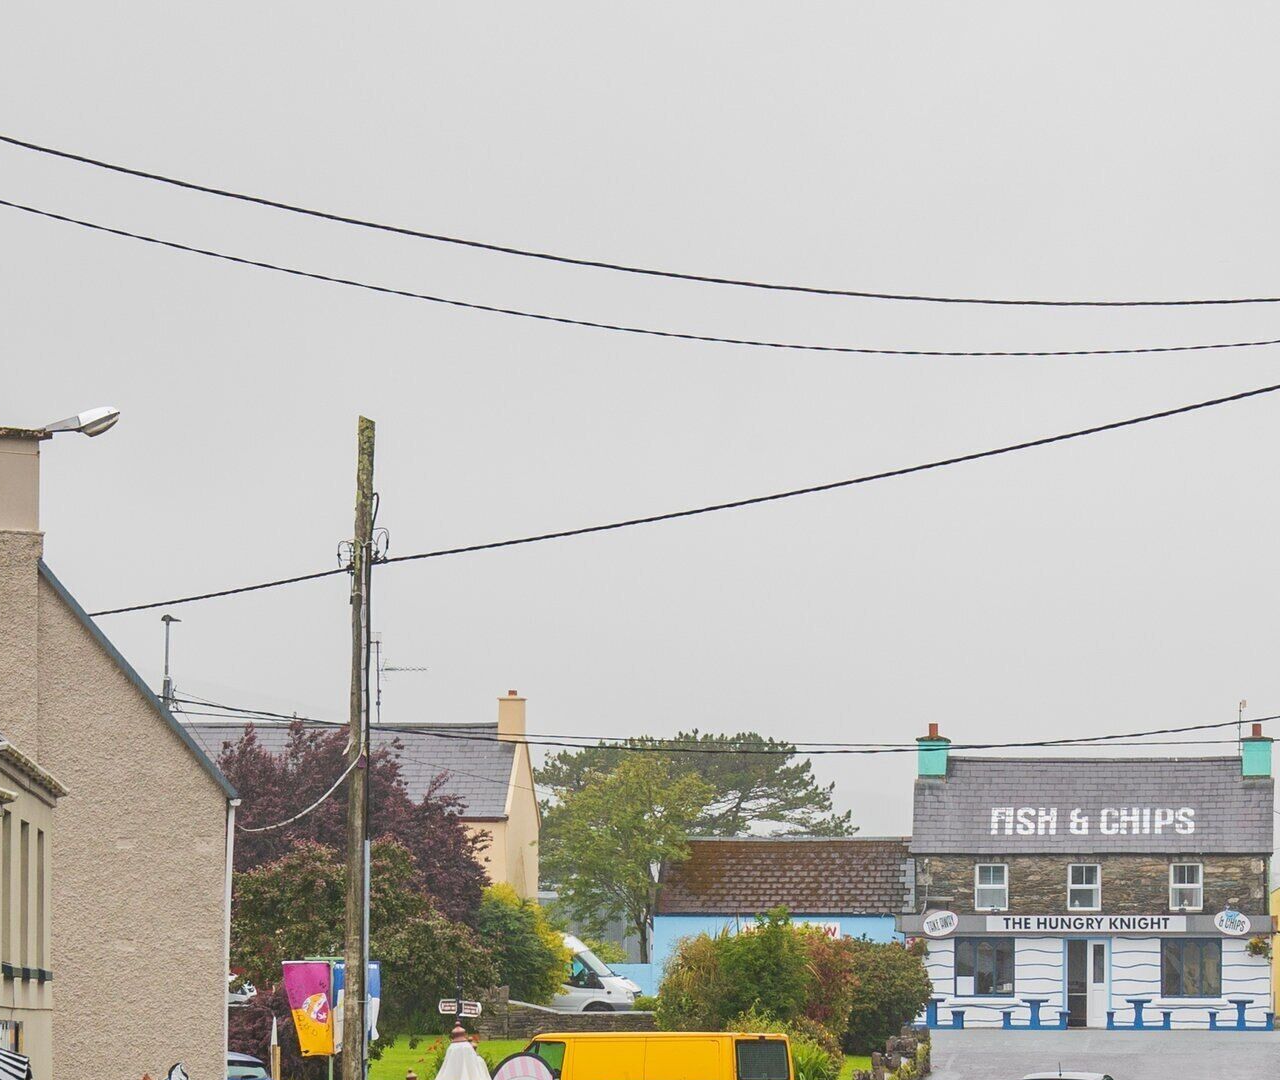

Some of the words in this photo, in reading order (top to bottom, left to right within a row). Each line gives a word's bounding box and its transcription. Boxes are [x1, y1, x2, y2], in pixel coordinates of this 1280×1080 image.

[990, 807, 1058, 835] FISH
[1069, 808, 1089, 835] &
[1099, 807, 1196, 835] CHIPS
[1003, 917, 1032, 930] THE
[1037, 917, 1105, 931] HUNGRY
[1109, 917, 1170, 930] KNIGHT
[1224, 917, 1246, 932] CHIPS
